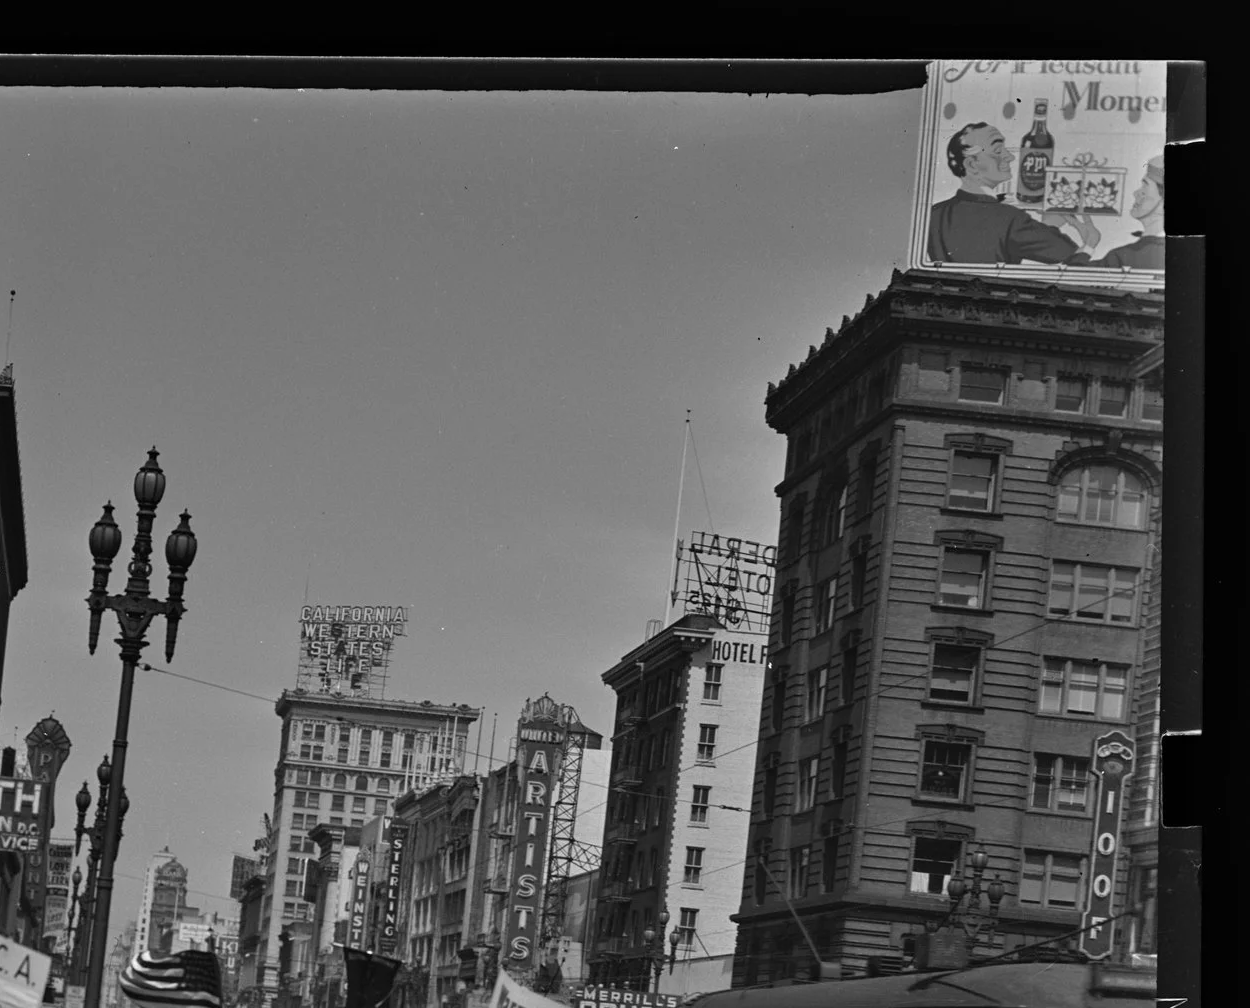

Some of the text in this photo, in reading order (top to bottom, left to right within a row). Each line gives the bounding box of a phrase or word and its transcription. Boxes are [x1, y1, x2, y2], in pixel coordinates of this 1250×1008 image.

[1061, 80, 1166, 112] Mome
[301, 605, 405, 622] CALIFORNIA
[304, 623, 394, 639] WESTERN
[310, 640, 384, 656] STATES
[712, 640, 756, 664] HOTEL
[326, 656, 370, 673] LIFE
[509, 749, 549, 961] ARTISTS
[384, 839, 403, 937] STERLING
[584, 987, 677, 1008] MERRILL'S
